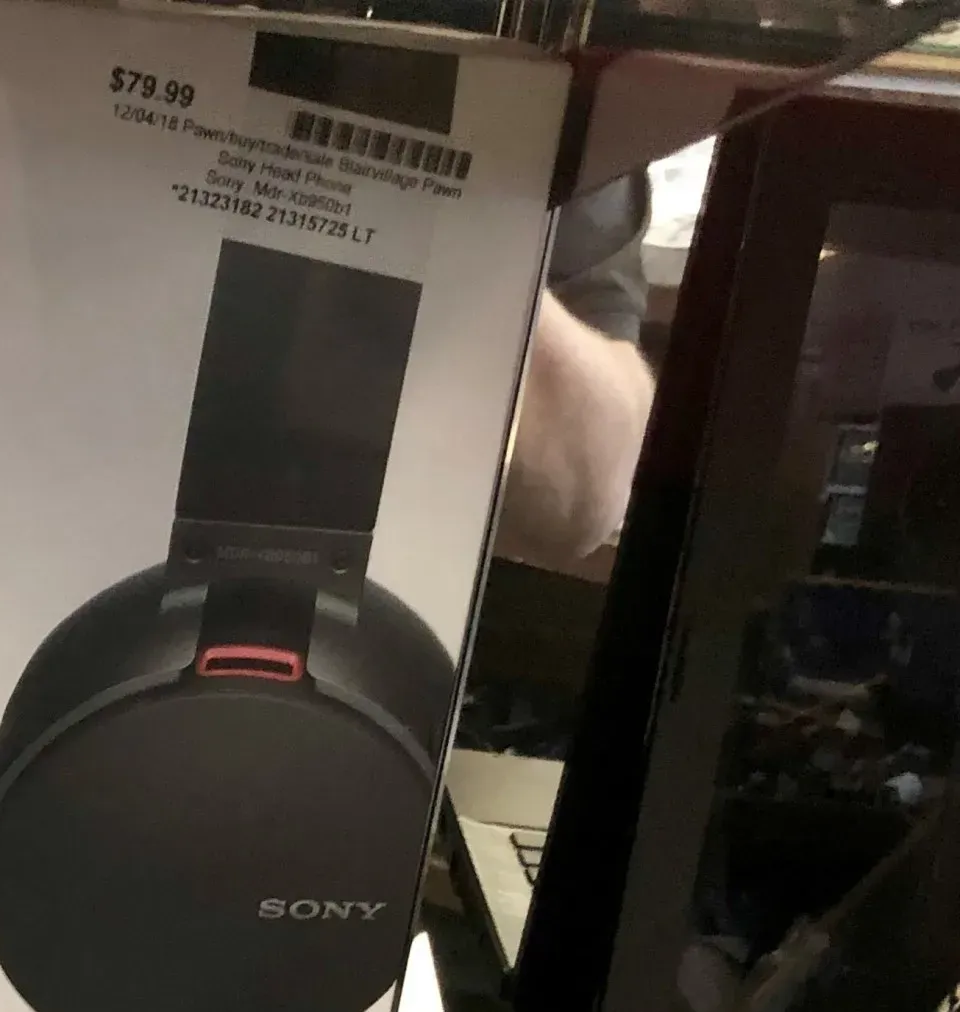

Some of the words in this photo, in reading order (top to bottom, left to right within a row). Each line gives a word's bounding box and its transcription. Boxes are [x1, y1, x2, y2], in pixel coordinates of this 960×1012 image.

[109, 65, 195, 108] $79.99
[113, 104, 179, 131] 12/04/18
[339, 153, 418, 191] Blairvillage
[421, 177, 463, 200] Pawn
[217, 150, 257, 175] Sony
[260, 162, 301, 183] Head
[304, 171, 353, 195] Phone
[205, 169, 246, 192] Sony
[265, 206, 349, 239] 21315725
[351, 226, 377, 245] LT
[257, 898, 388, 920] SONY
